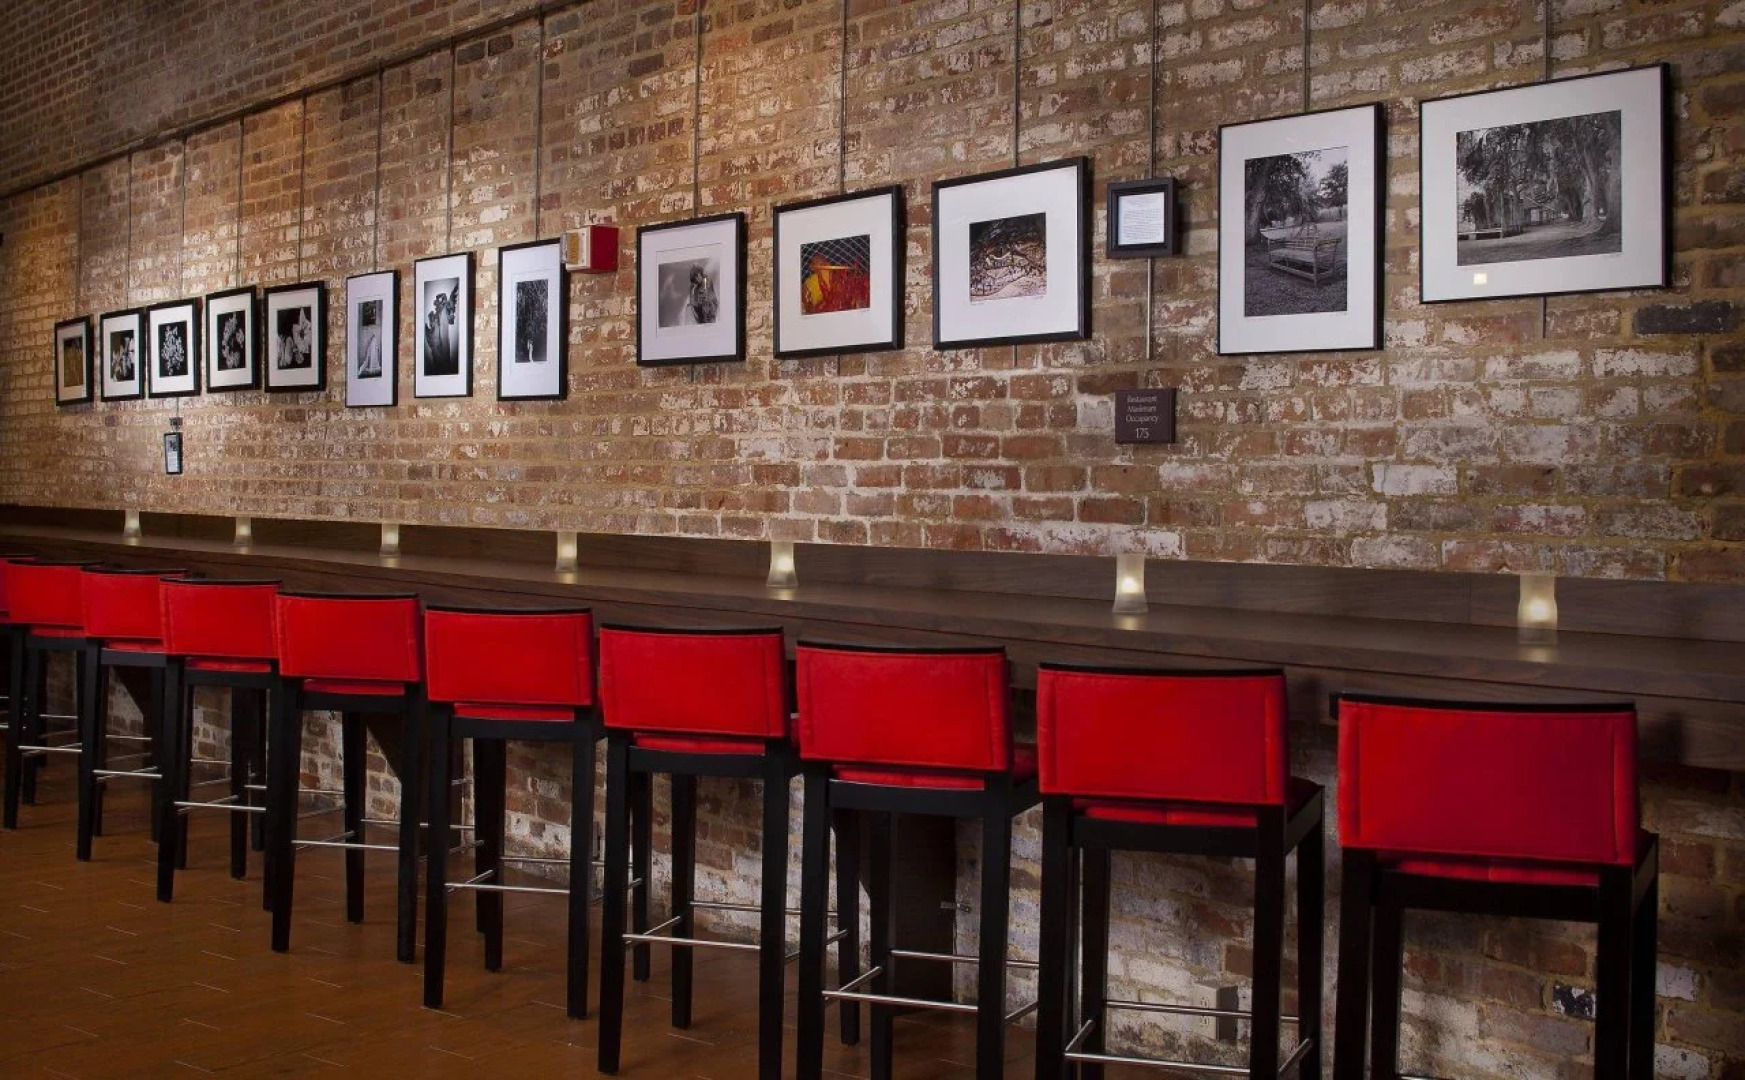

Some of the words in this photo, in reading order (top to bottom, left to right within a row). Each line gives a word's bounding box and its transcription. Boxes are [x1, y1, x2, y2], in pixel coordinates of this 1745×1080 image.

[1127, 405, 1157, 413] Maximum
[1125, 415, 1159, 424] Occupancy
[1136, 427, 1150, 439] 175
